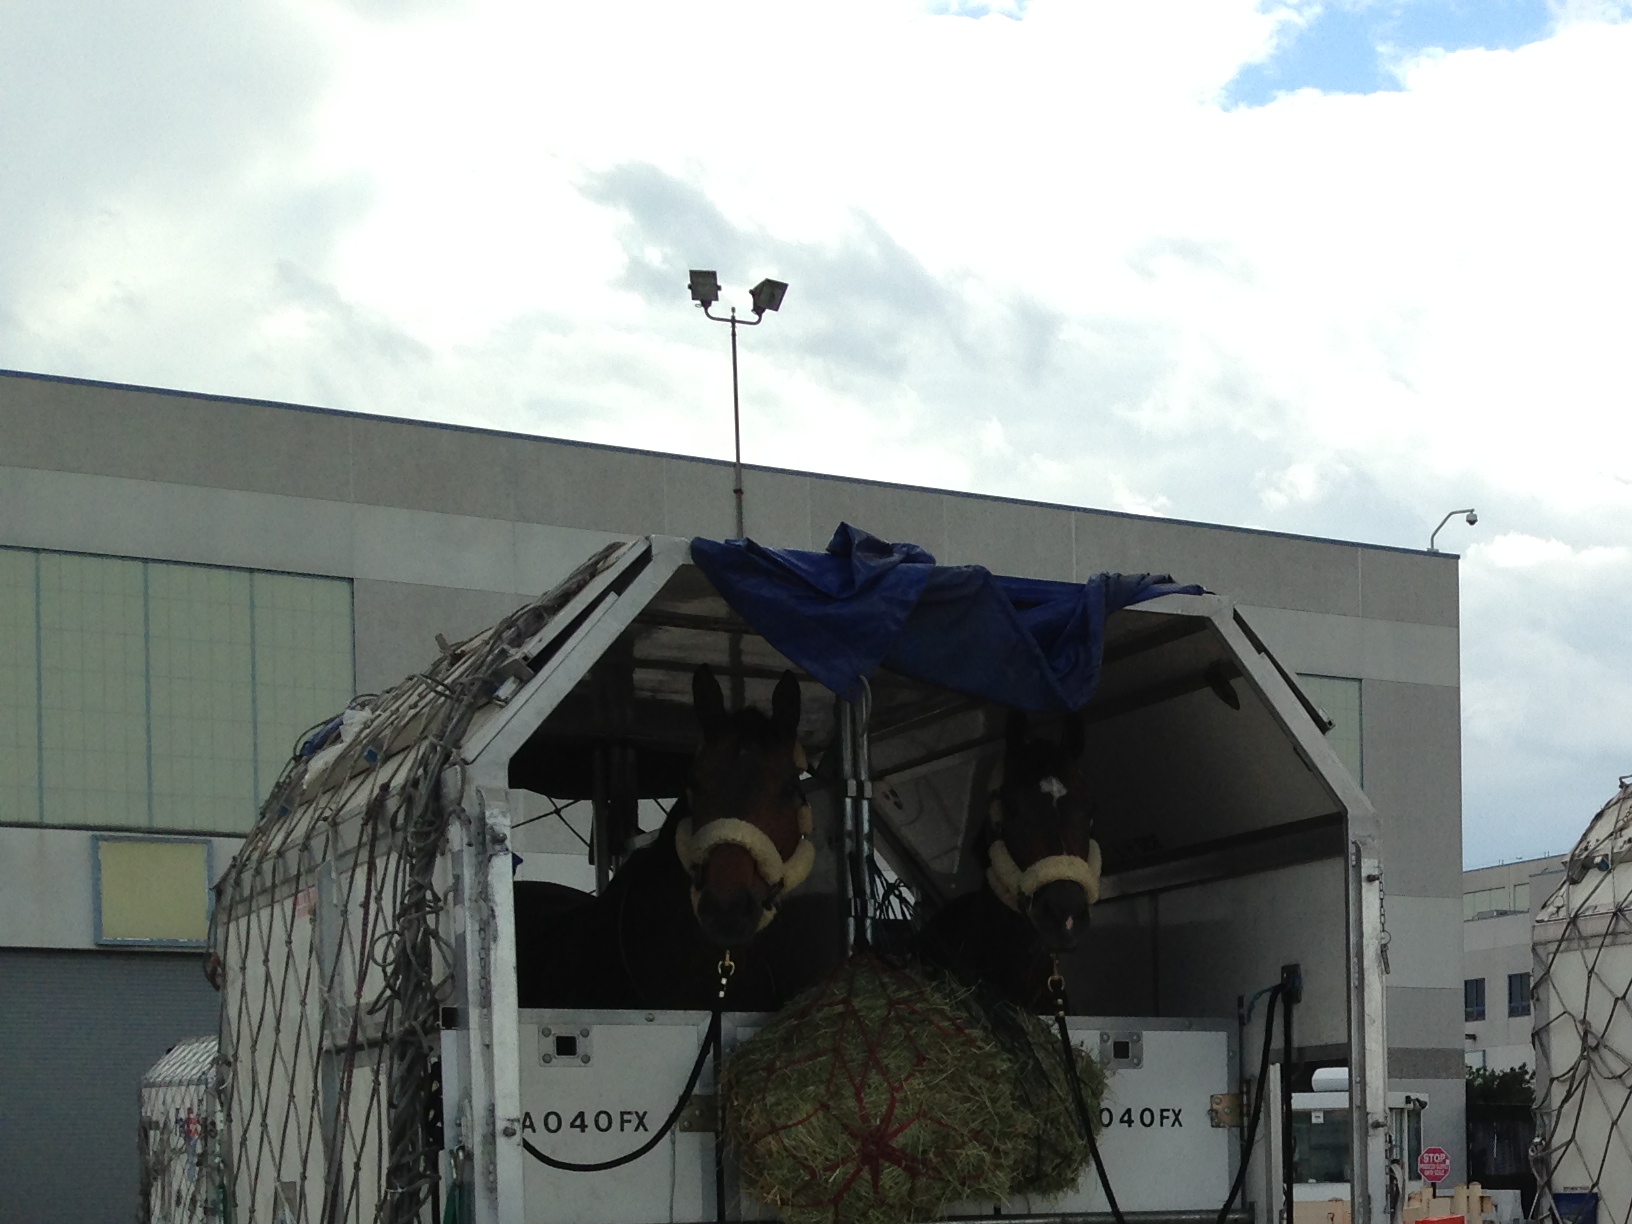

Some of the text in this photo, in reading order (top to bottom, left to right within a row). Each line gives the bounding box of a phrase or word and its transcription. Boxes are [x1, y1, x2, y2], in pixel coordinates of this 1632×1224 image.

[522, 1110, 649, 1134] A040FX
[1100, 1107, 1183, 1128] 040FX
[1423, 1153, 1446, 1164] STOP
